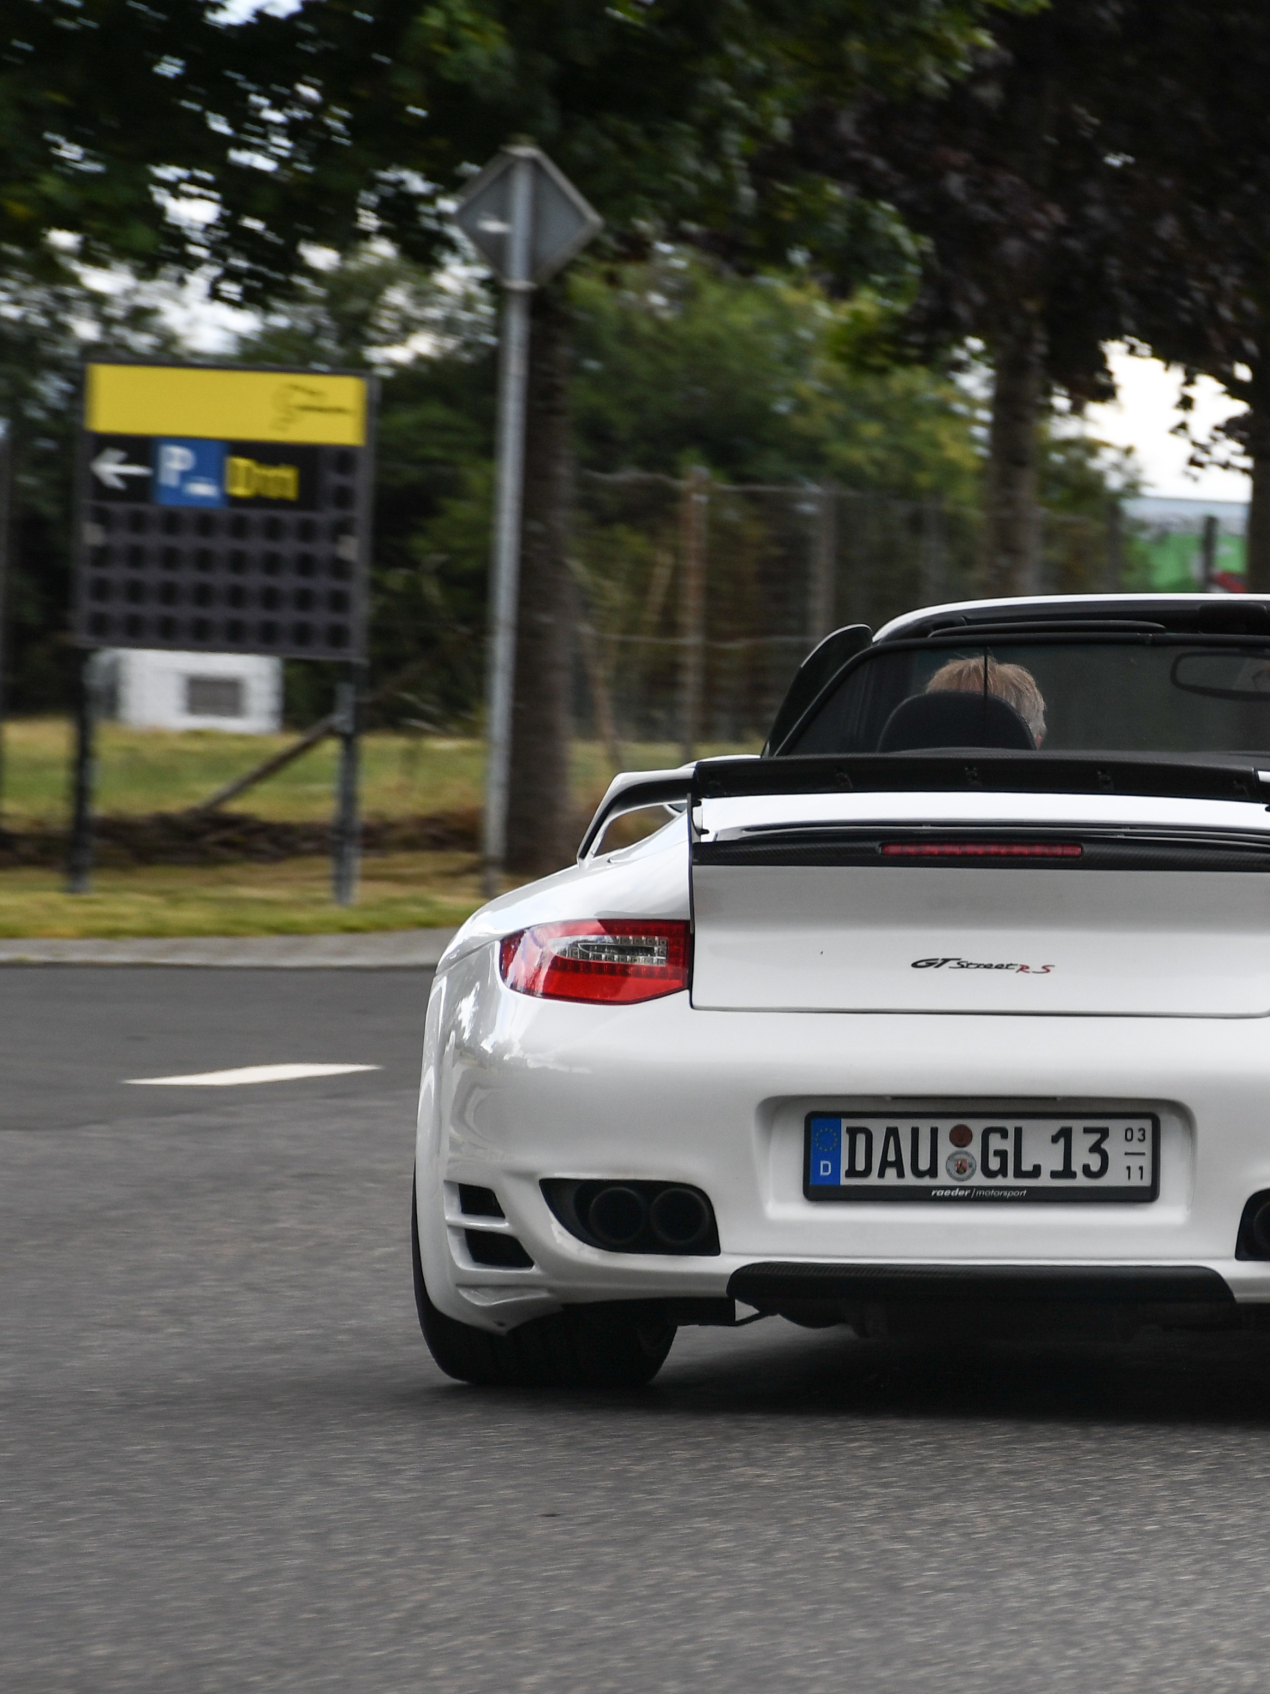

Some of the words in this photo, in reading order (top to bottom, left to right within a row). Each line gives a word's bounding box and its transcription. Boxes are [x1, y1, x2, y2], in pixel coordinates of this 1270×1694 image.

[1124, 1128, 1146, 1142] 03
[845, 1126, 939, 1178] DAU
[819, 1161, 831, 1176] D
[1126, 1166, 1146, 1180] 11
